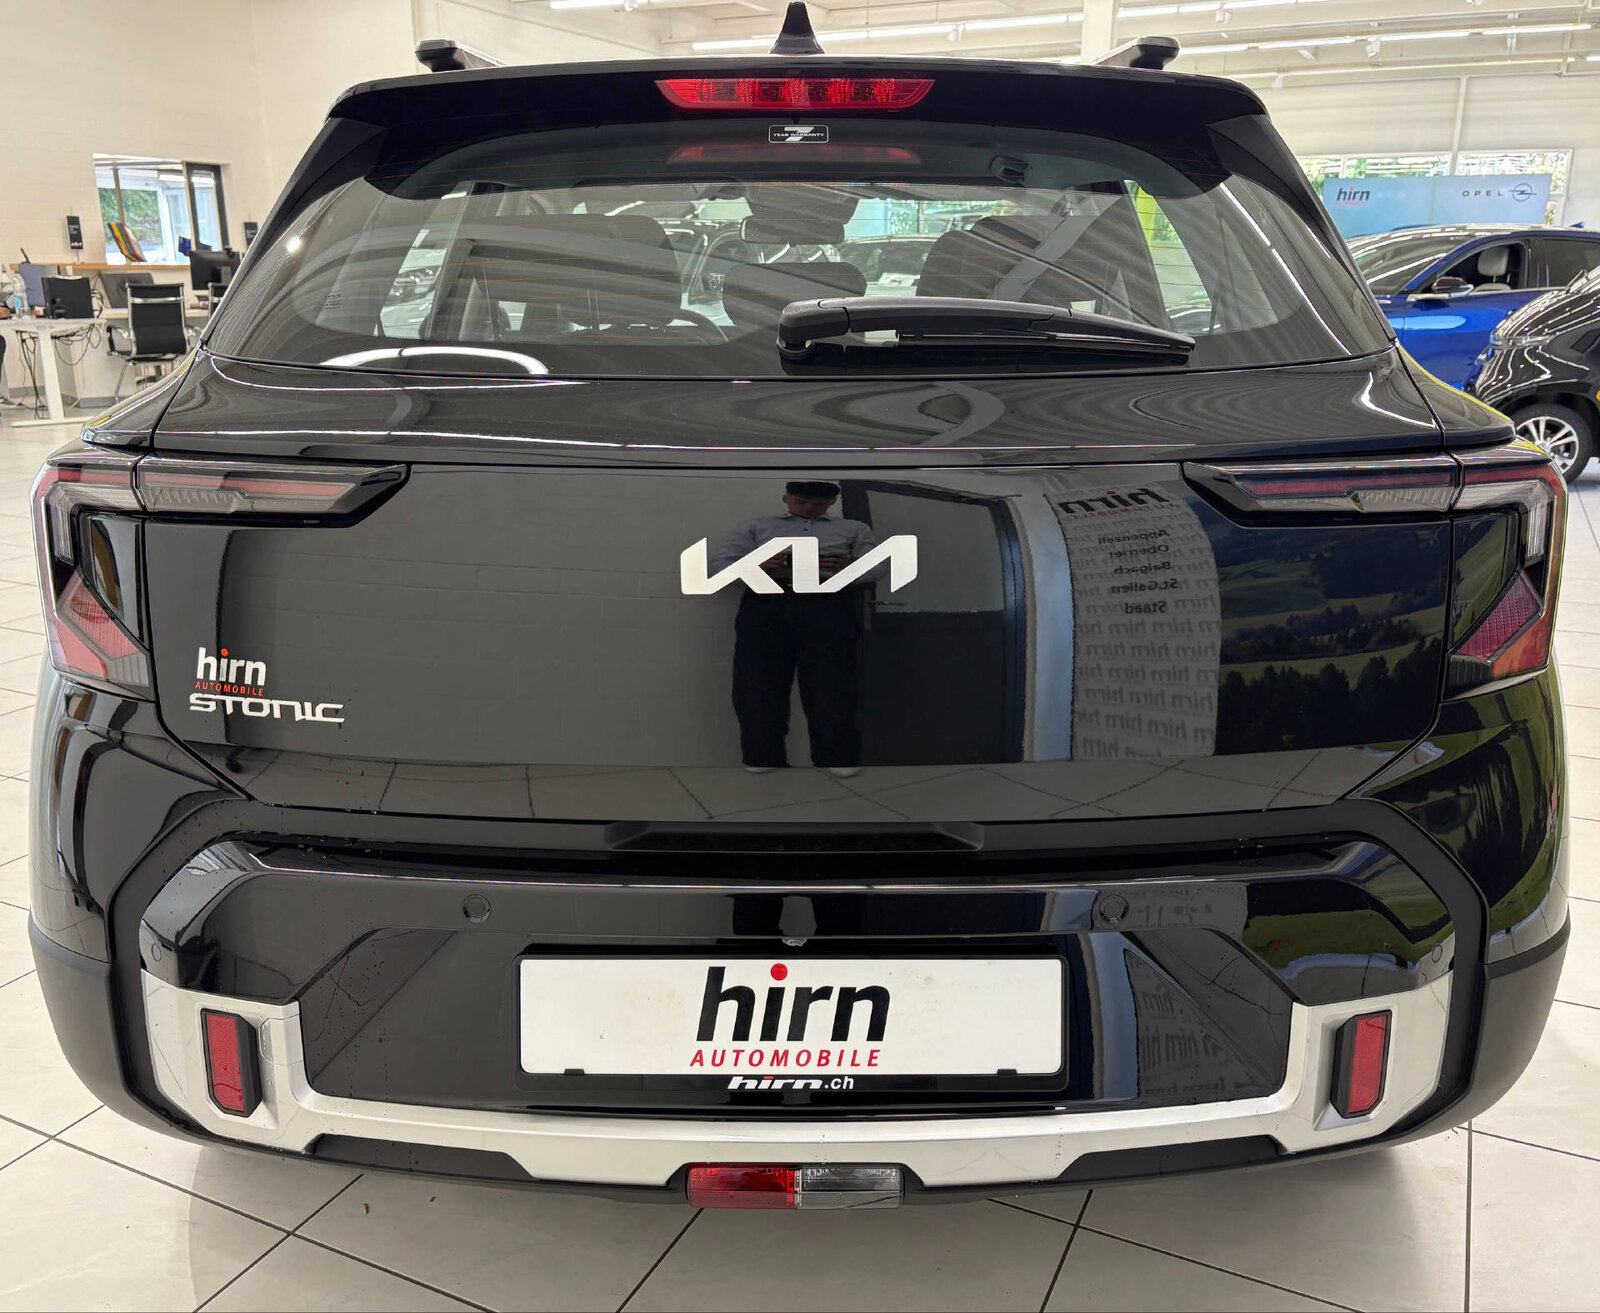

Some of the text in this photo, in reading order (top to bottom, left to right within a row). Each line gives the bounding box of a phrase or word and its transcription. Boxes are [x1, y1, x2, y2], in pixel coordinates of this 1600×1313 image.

[1336, 187, 1370, 201] hirn
[680, 535, 917, 594] KIA
[196, 647, 267, 686] hirn
[195, 681, 265, 697] AUTOMOBILE
[189, 692, 345, 723] STONIC
[696, 963, 891, 1042] hirn
[690, 1049, 881, 1067] AUTOMOBILE
[727, 1075, 854, 1090] hirn.ch
